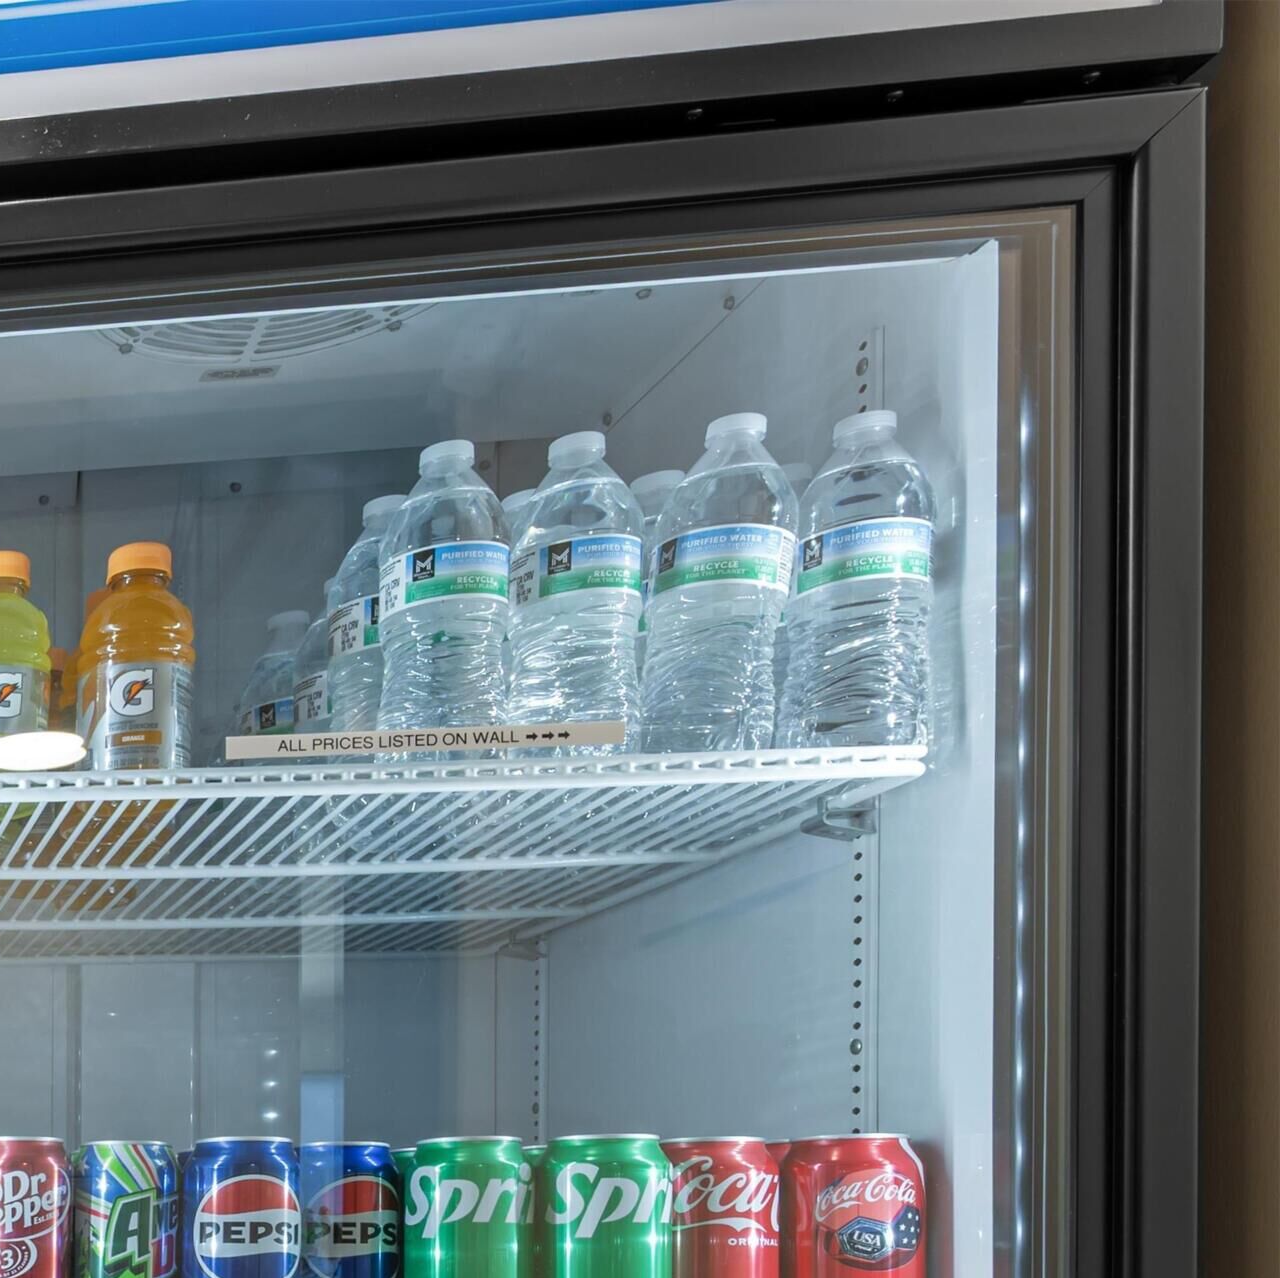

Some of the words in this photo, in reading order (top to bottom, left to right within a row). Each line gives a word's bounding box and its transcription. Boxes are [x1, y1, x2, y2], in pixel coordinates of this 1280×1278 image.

[730, 533, 764, 544] WATER
[831, 530, 881, 545] PURIFIED
[882, 528, 916, 539] WATER
[442, 549, 487, 561] PURIFIED
[578, 544, 620, 554] PURIFIED
[692, 559, 740, 572] RECYCLE
[109, 668, 155, 717] G
[278, 738, 307, 753] ALL
[312, 736, 375, 751] PRICES
[378, 733, 439, 749] LISTED
[442, 732, 468, 746] ON
[472, 731, 520, 744] WALL
[3, 1170, 48, 1199] Dr
[814, 1172, 916, 1223] Coca-Cola
[199, 1220, 299, 1246] PEPSI
[853, 1230, 882, 1248] USA
